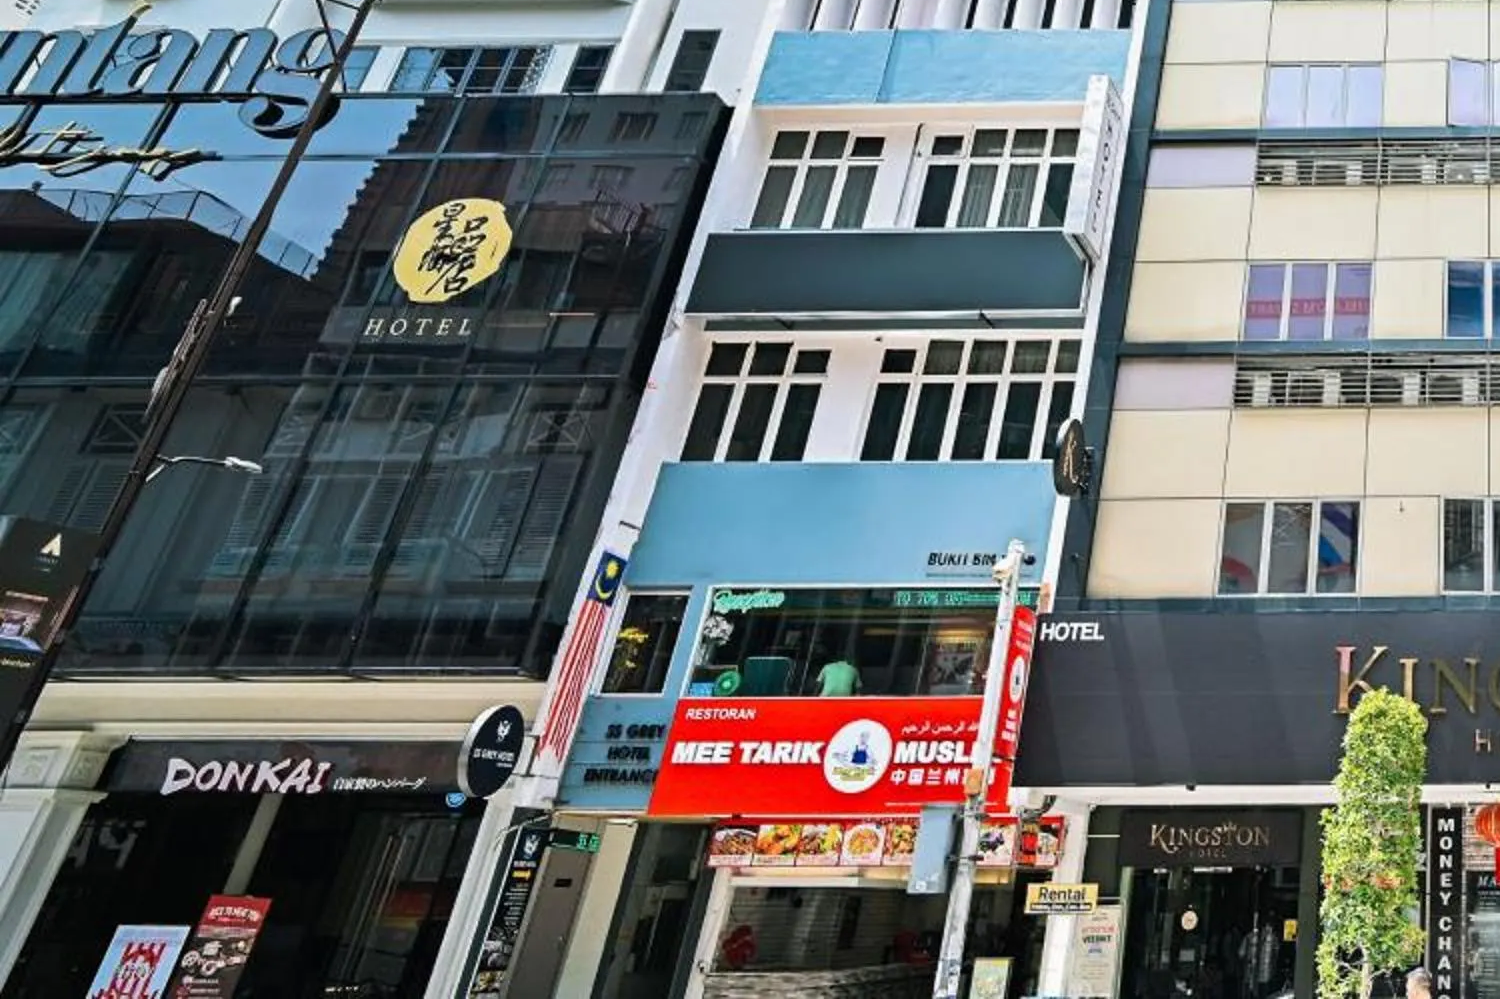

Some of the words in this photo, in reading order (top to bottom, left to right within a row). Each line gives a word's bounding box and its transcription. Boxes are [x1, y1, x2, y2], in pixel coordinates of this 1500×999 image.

[363, 317, 473, 337] HOTEL
[927, 552, 969, 566] BUKIT
[1040, 622, 1105, 642] HOTEL
[685, 707, 757, 720] RESTORAN
[671, 741, 734, 764] MEE
[739, 741, 826, 764] TARIK
[893, 741, 1003, 764] MUSL
[160, 757, 332, 796] DONKAI
[890, 767, 996, 786] 中国兰州
[1150, 821, 1271, 854] KINGSTON
[1436, 817, 1456, 907] MONEY
[1037, 886, 1087, 900] Rental
